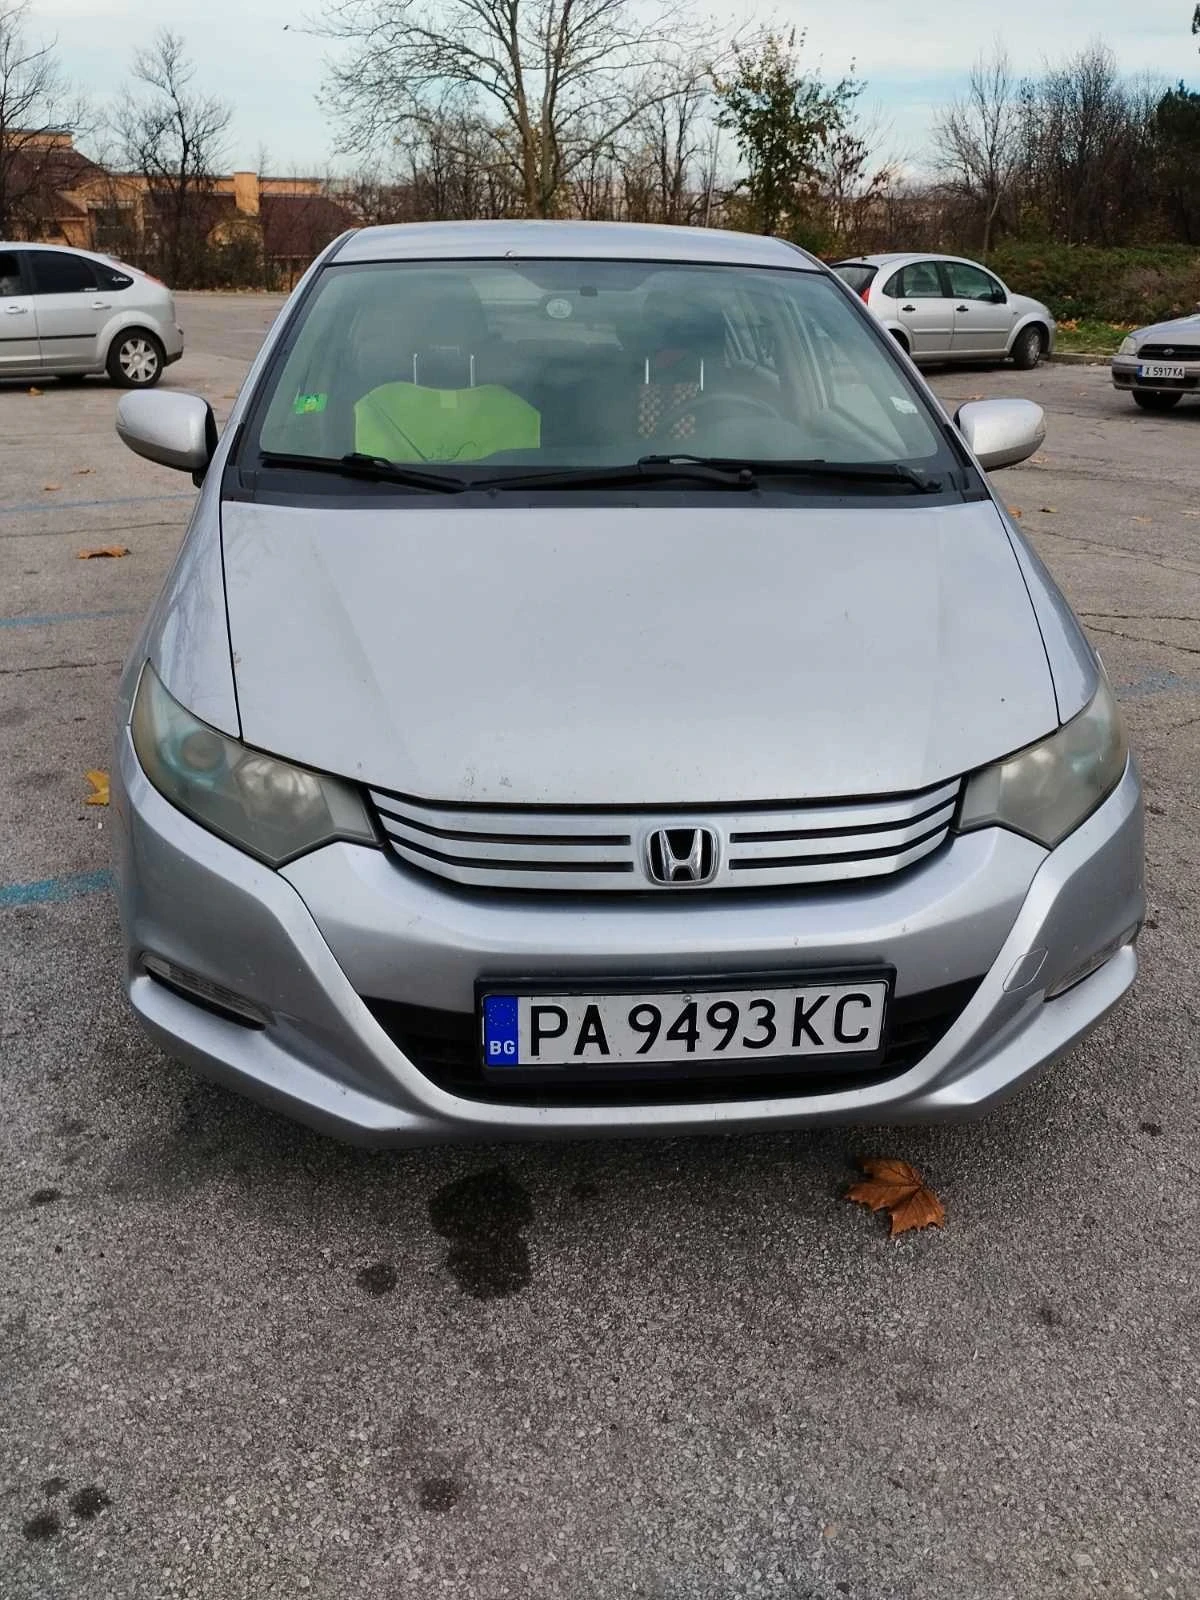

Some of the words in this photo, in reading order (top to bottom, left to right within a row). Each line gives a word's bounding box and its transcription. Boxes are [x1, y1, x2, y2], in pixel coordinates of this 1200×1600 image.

[1153, 367, 1172, 377] 5917
[1173, 367, 1183, 377] KA
[531, 1005, 610, 1056] PA
[628, 998, 776, 1055] 9493
[792, 993, 872, 1047] KC
[489, 1040, 516, 1055] BG
